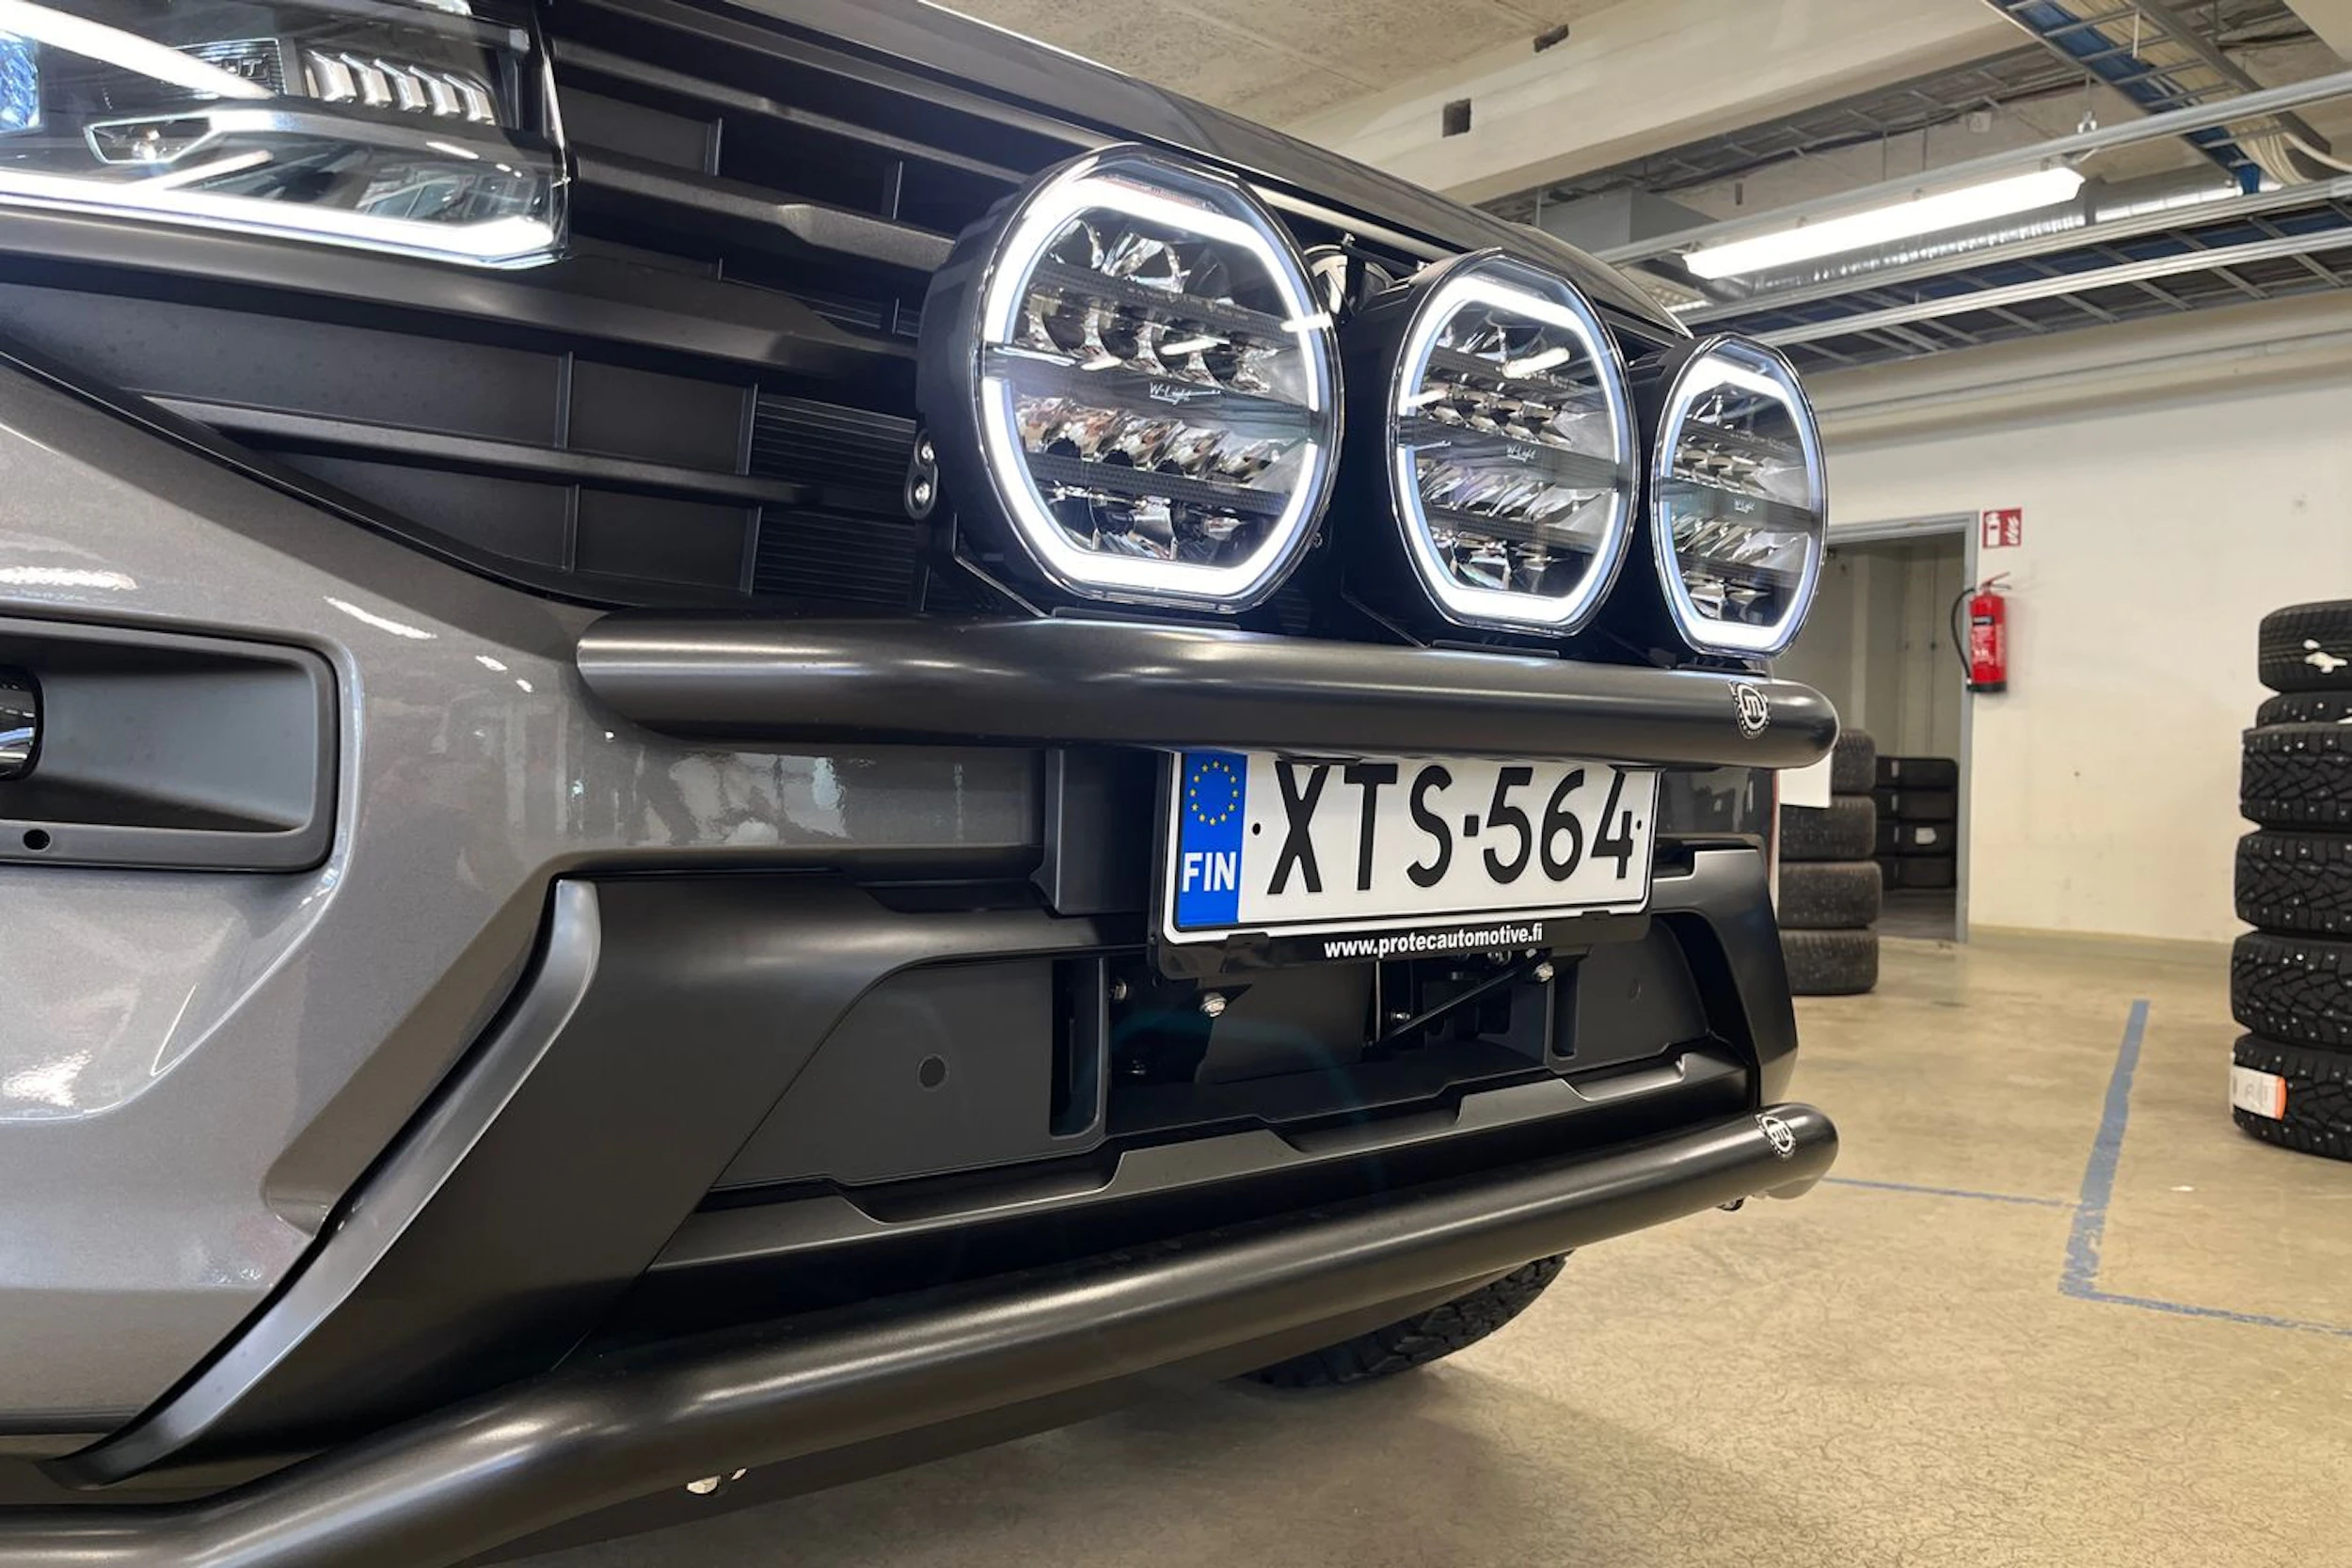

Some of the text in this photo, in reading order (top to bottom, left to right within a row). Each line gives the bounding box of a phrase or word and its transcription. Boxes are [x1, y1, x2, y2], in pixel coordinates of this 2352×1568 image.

[1266, 760, 1633, 895] XTS-564
[1181, 851, 1237, 893] FIN
[1324, 923, 1544, 959] www.protecautomotive.fi
